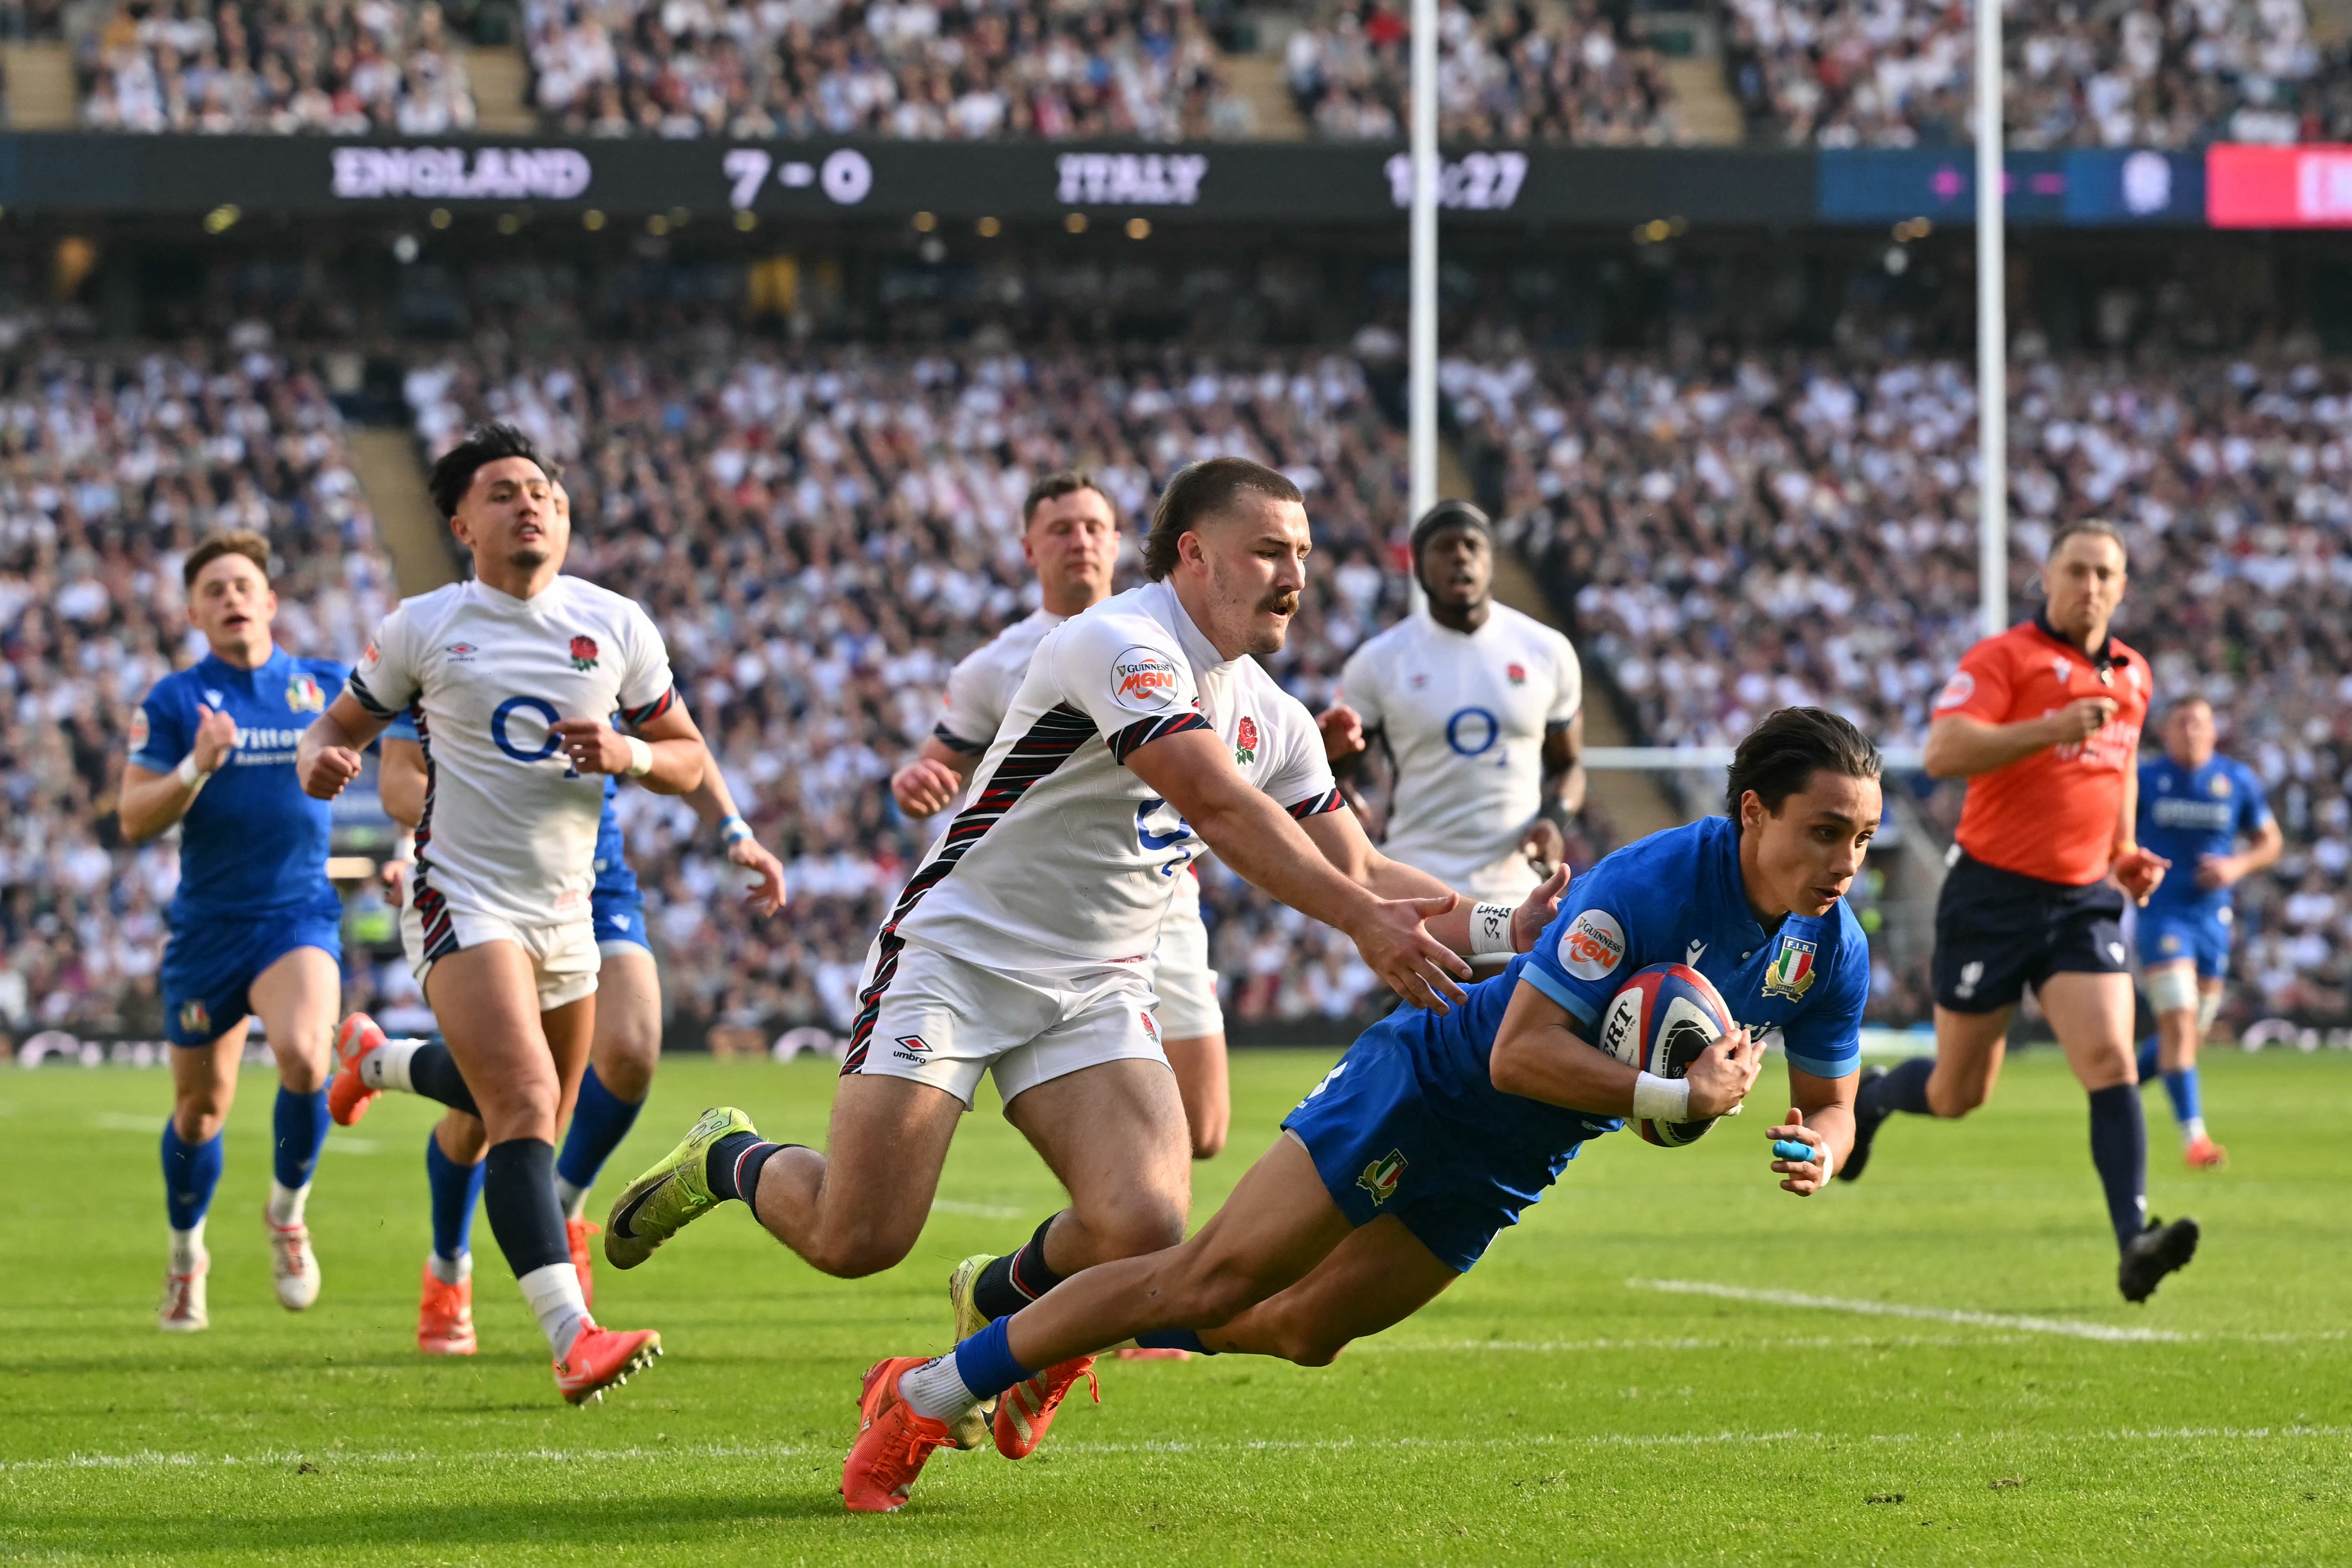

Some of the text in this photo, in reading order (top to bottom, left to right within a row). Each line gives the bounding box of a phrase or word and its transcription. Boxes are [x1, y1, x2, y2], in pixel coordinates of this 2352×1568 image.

[330, 147, 591, 198] ENGLAND
[1055, 153, 1209, 205] ITALY
[1127, 664, 1169, 673] GUINNESS
[1118, 672, 1173, 695] M6N
[1583, 923, 1622, 952] GUINNESS
[1564, 931, 1619, 968] M6N
[1787, 941, 1811, 953] F.I.R.
[893, 1051, 926, 1064] umbro
[1368, 1181, 1380, 1194] ITALIA
